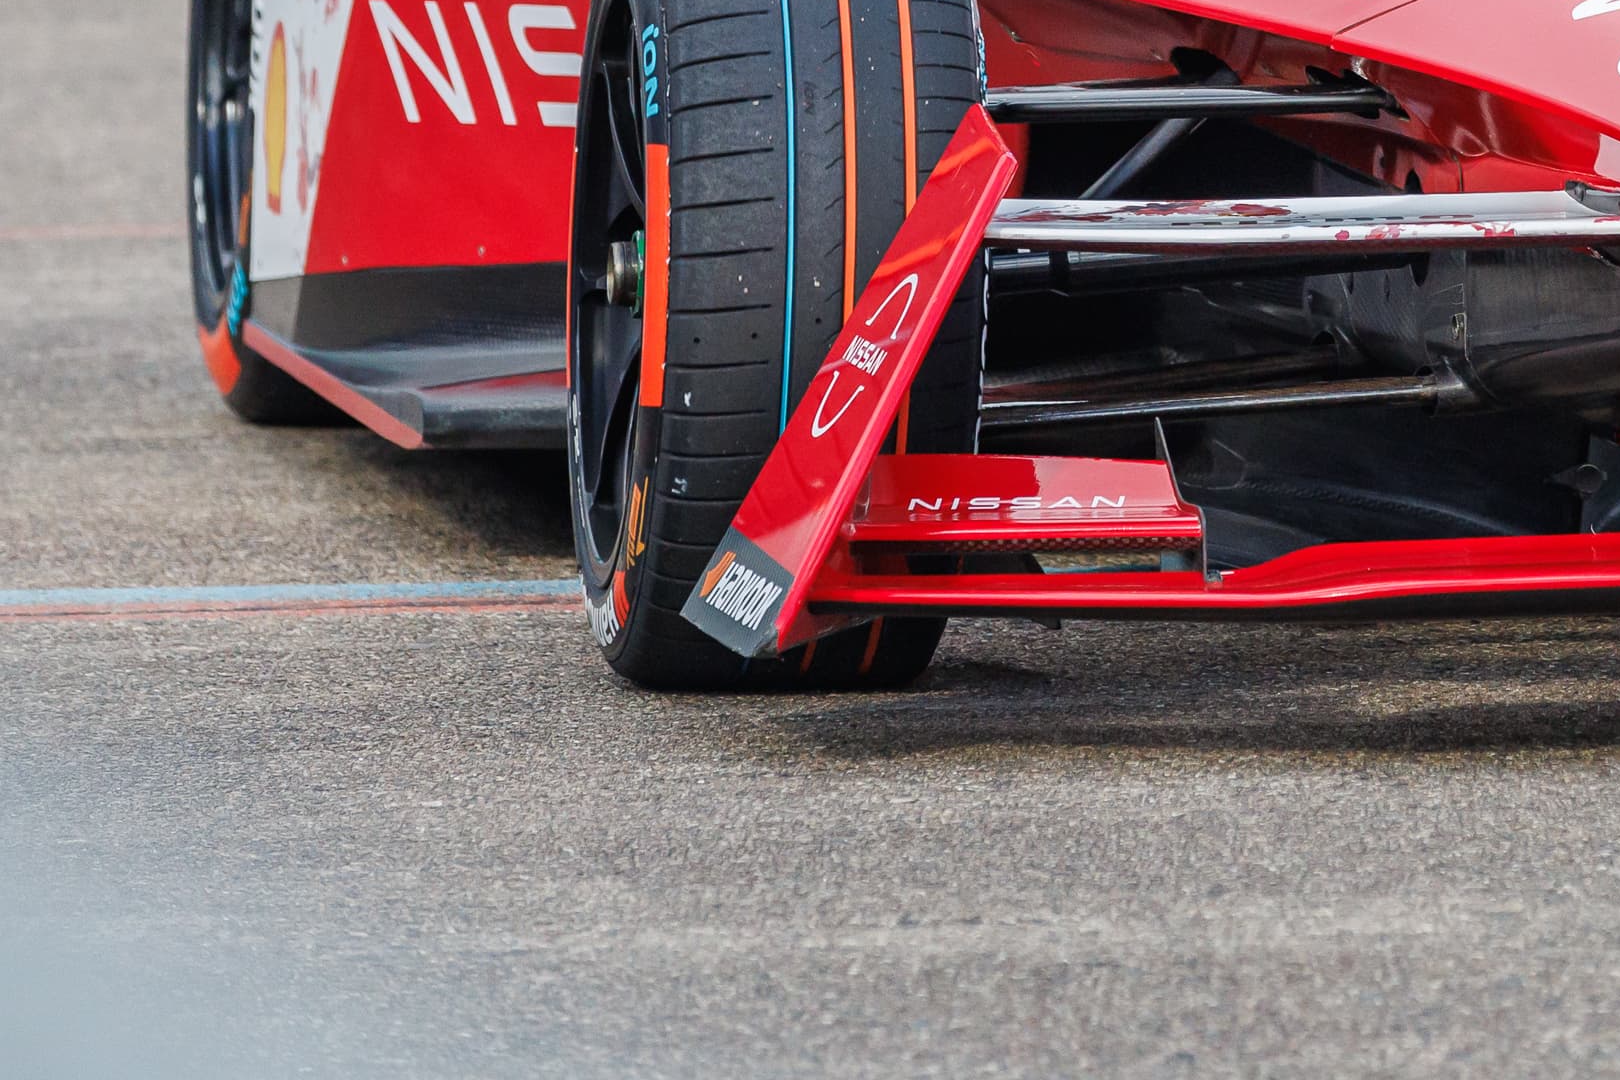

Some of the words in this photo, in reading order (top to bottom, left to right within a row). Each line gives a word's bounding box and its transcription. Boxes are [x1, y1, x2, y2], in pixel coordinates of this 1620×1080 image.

[368, 0, 583, 128] NIS
[842, 335, 888, 376] NISSAN
[908, 495, 1126, 511] NISSAN
